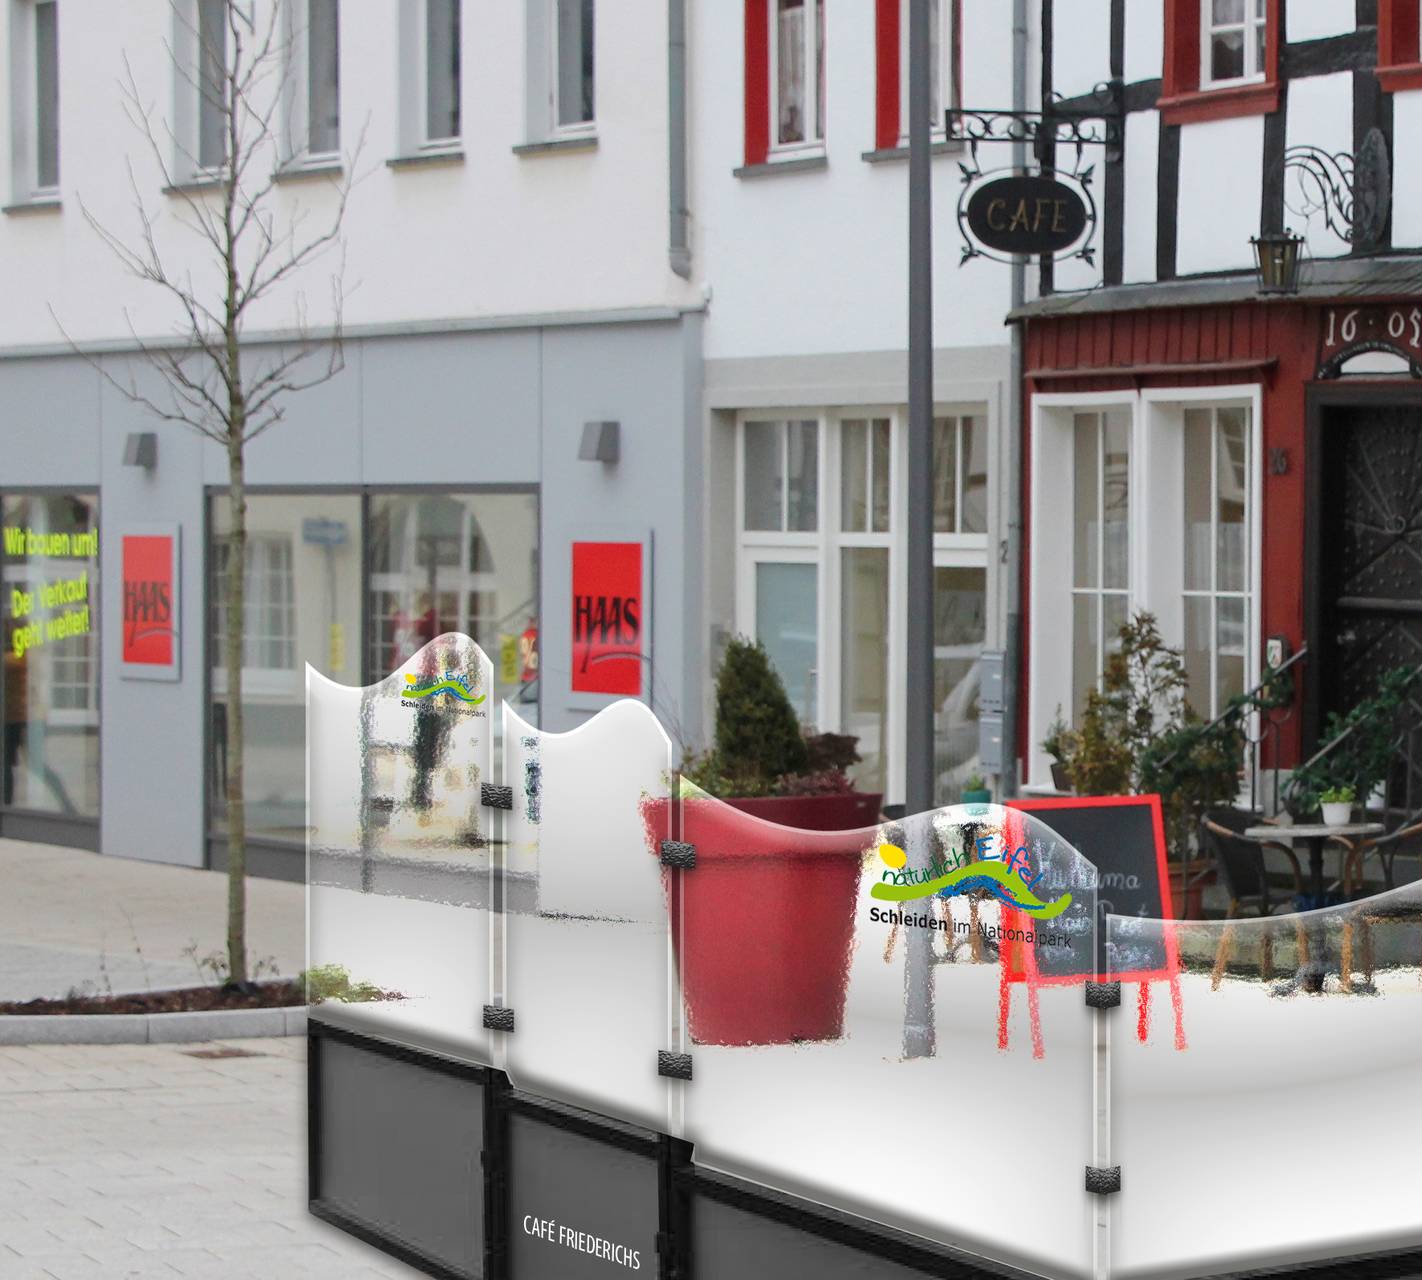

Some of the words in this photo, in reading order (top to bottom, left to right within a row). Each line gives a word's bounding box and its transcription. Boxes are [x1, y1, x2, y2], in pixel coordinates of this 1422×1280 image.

[986, 197, 1068, 233] CAFE
[4, 527, 25, 555] Wir
[27, 528, 70, 556] bauen
[124, 581, 171, 647] HAAS
[575, 595, 640, 672] HAAS
[975, 836, 1044, 891] Eifel
[870, 907, 948, 931] Schleiden
[953, 920, 971, 934] im
[976, 920, 1072, 948] Nationalpark
[523, 1215, 556, 1242] CAFÉ
[559, 1225, 640, 1270] FRIEDERICHS
